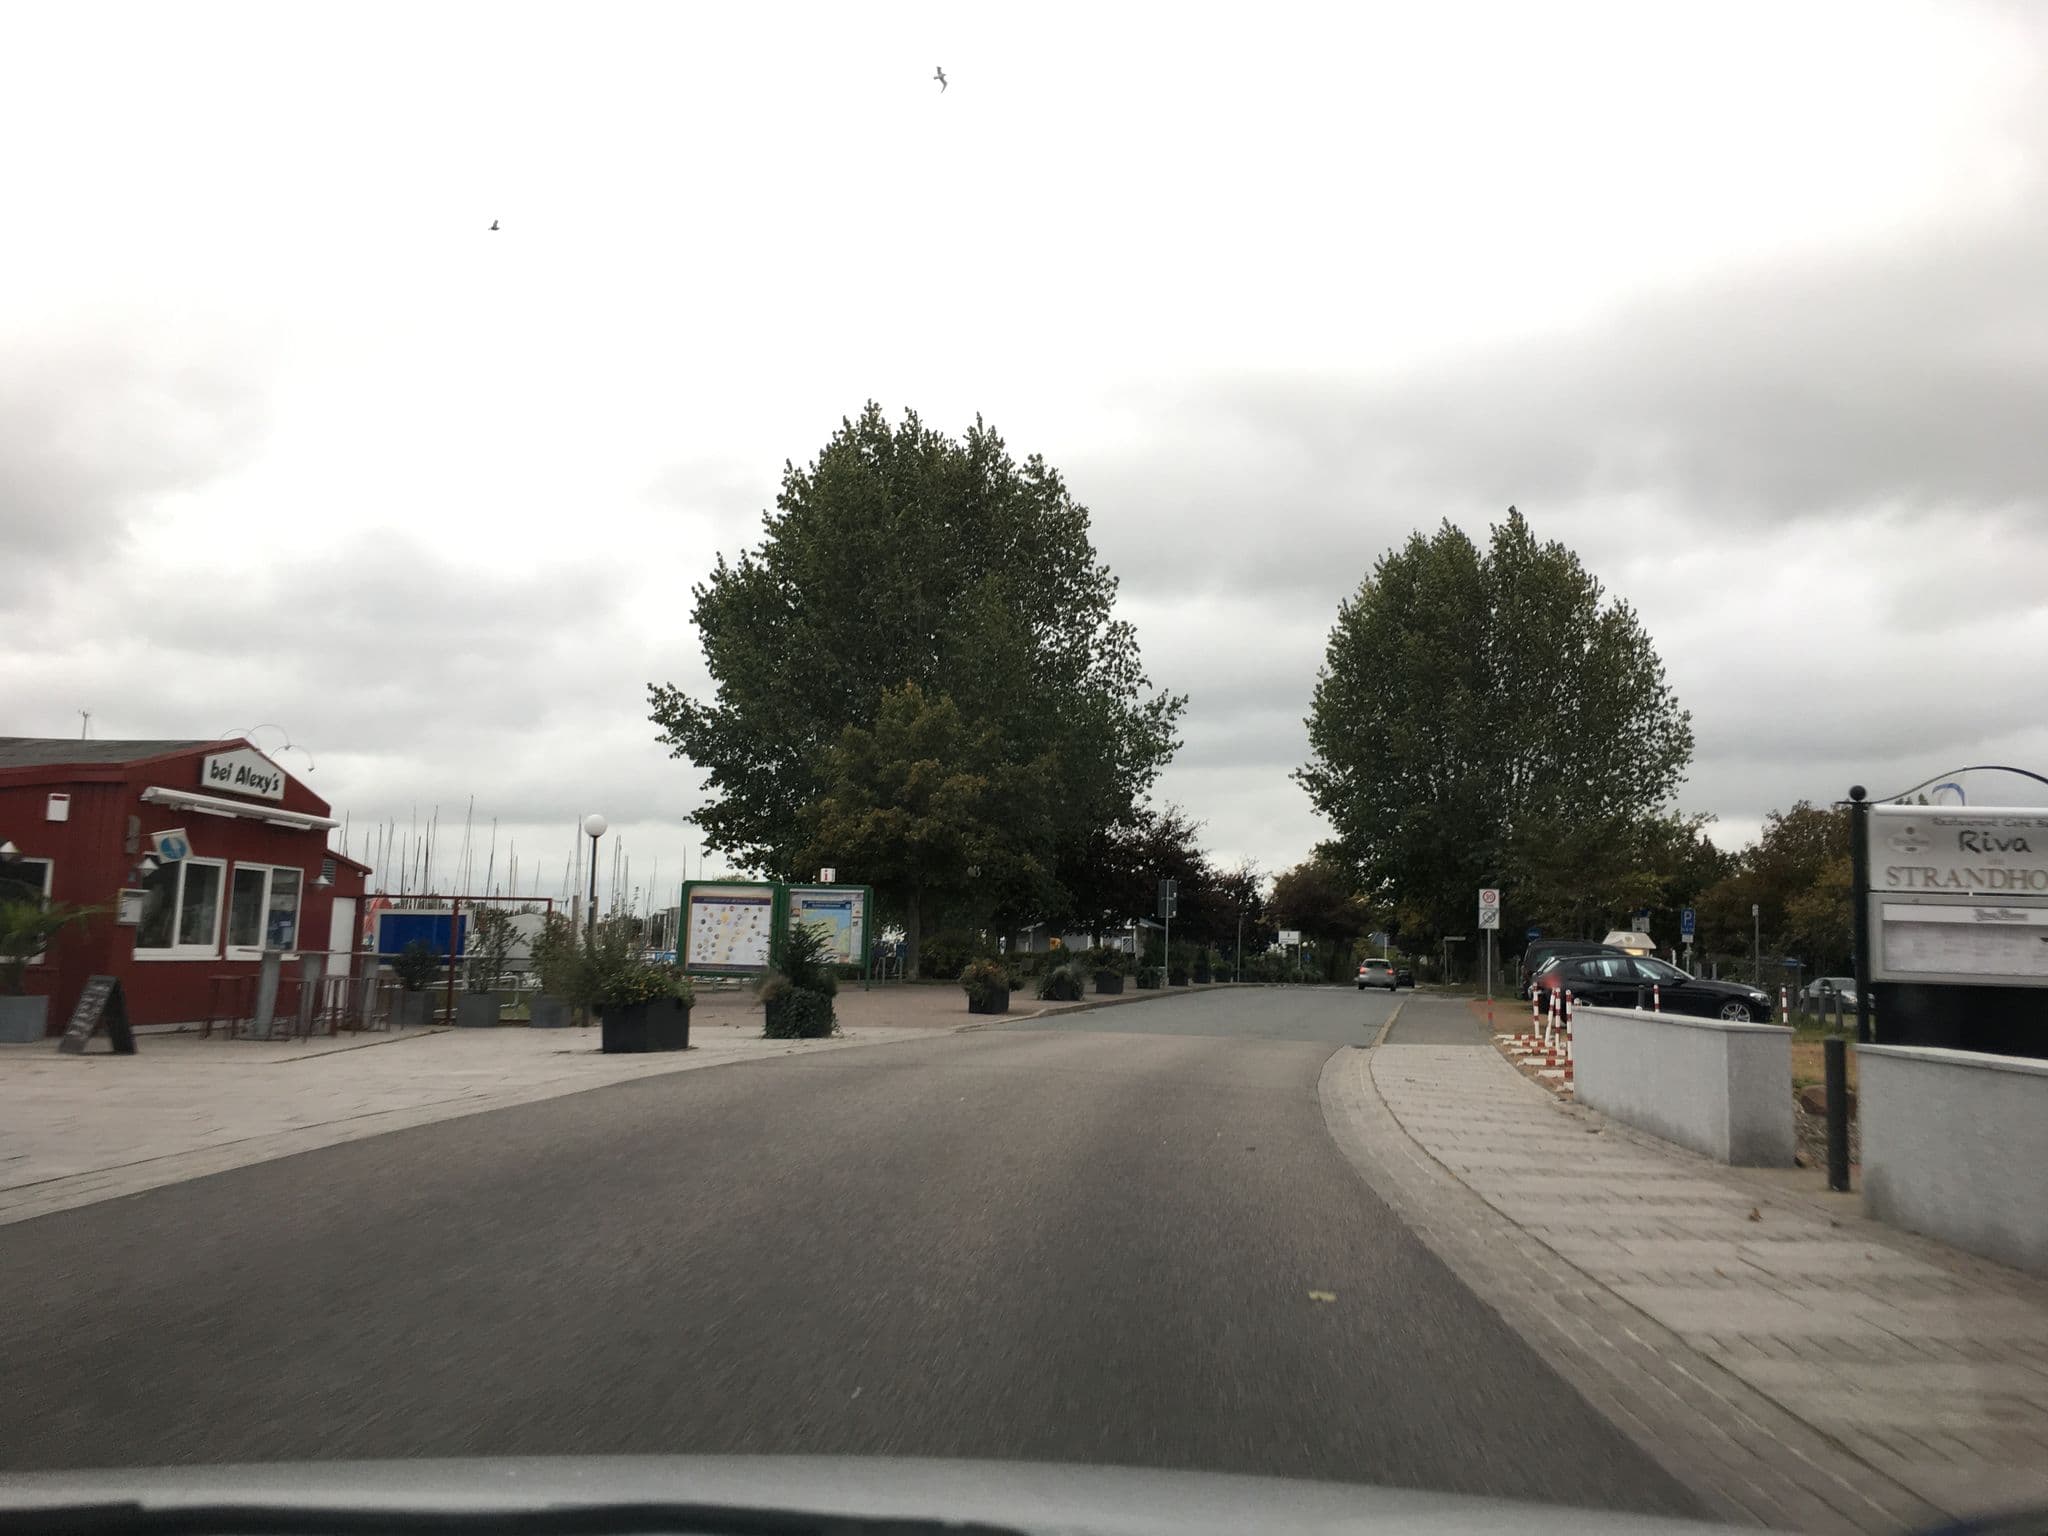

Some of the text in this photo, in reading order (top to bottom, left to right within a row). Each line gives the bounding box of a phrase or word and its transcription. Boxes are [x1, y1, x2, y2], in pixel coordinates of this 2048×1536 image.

[210, 759, 280, 794] bei Alexy's
[1958, 830, 2033, 853] Riva
[1886, 867, 2048, 890] STRANDHO
[1684, 910, 1692, 926] P
